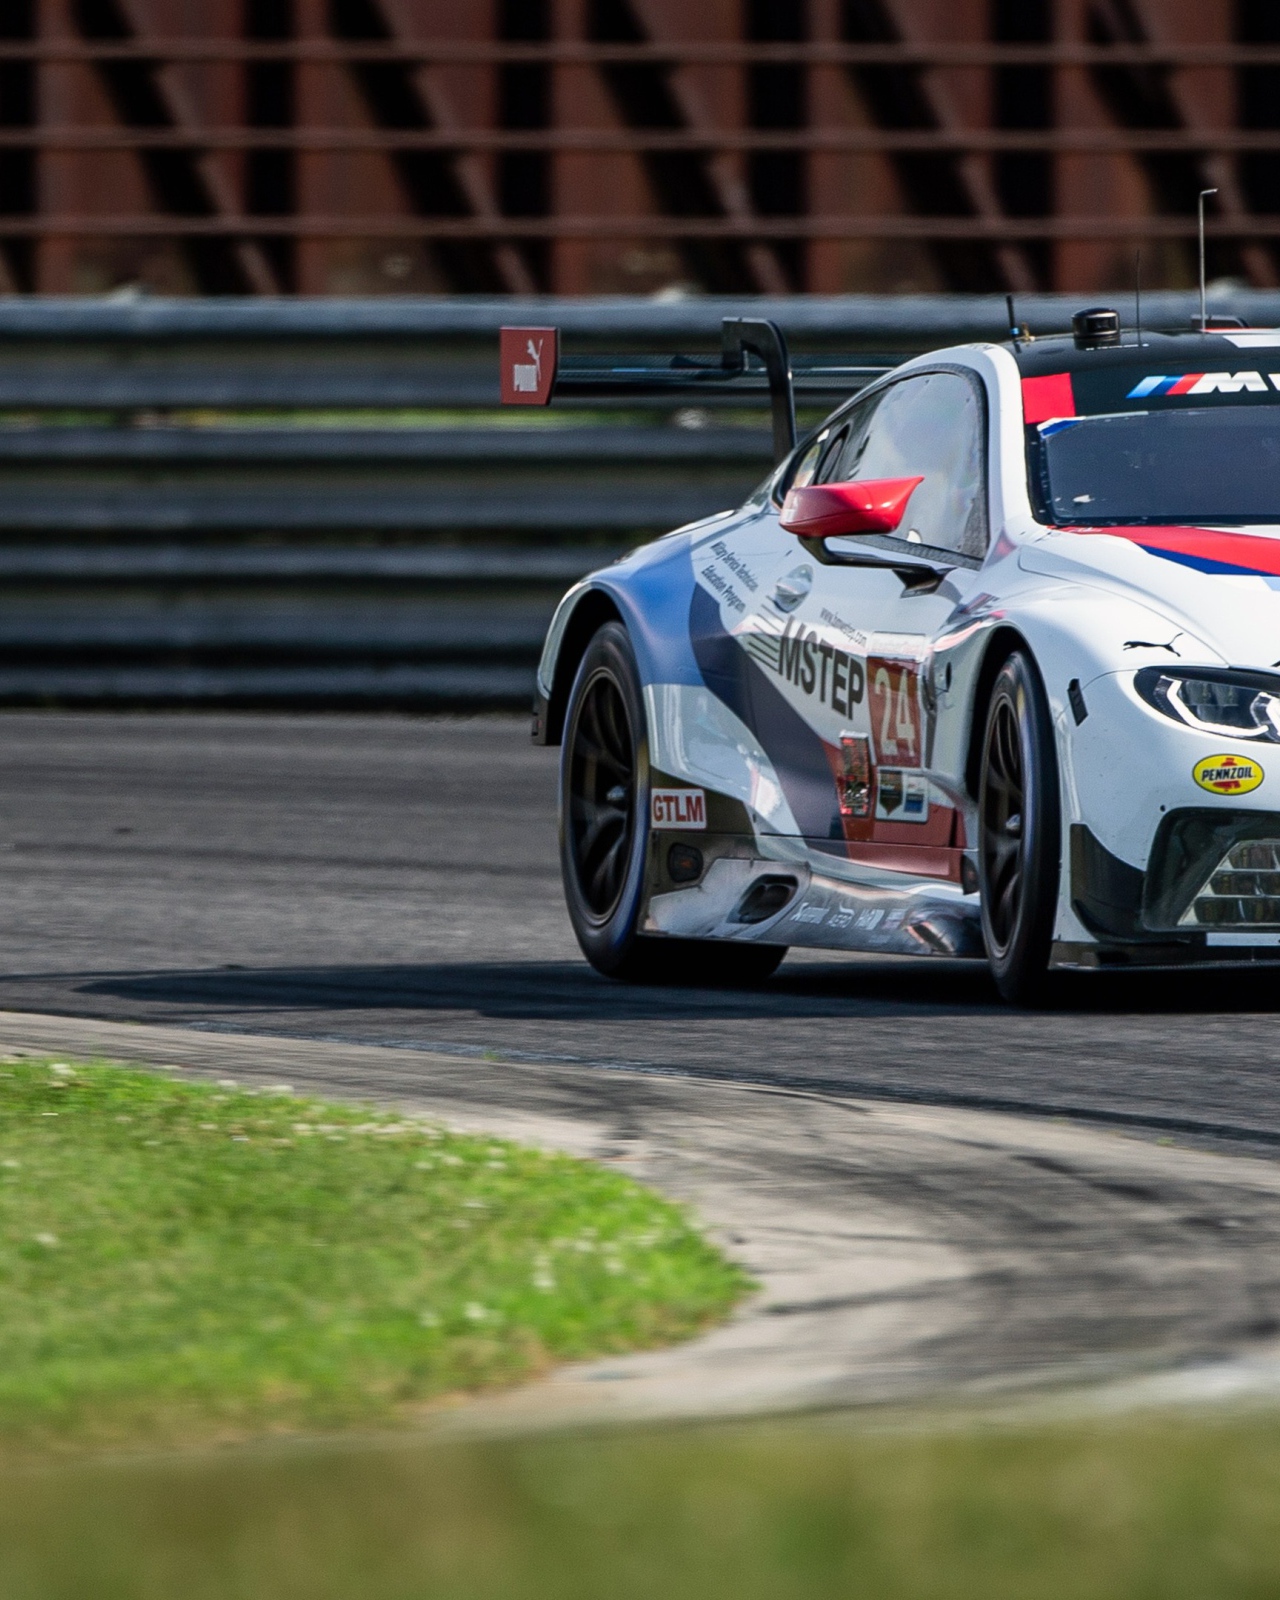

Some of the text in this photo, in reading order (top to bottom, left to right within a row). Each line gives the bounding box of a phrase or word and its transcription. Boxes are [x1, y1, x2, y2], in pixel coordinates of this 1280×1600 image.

[701, 564, 747, 614] Education Program
[778, 614, 864, 720] MSTEP
[875, 667, 916, 758] 24
[1202, 766, 1253, 782] PENNZOIL
[652, 794, 704, 823] GTLM
